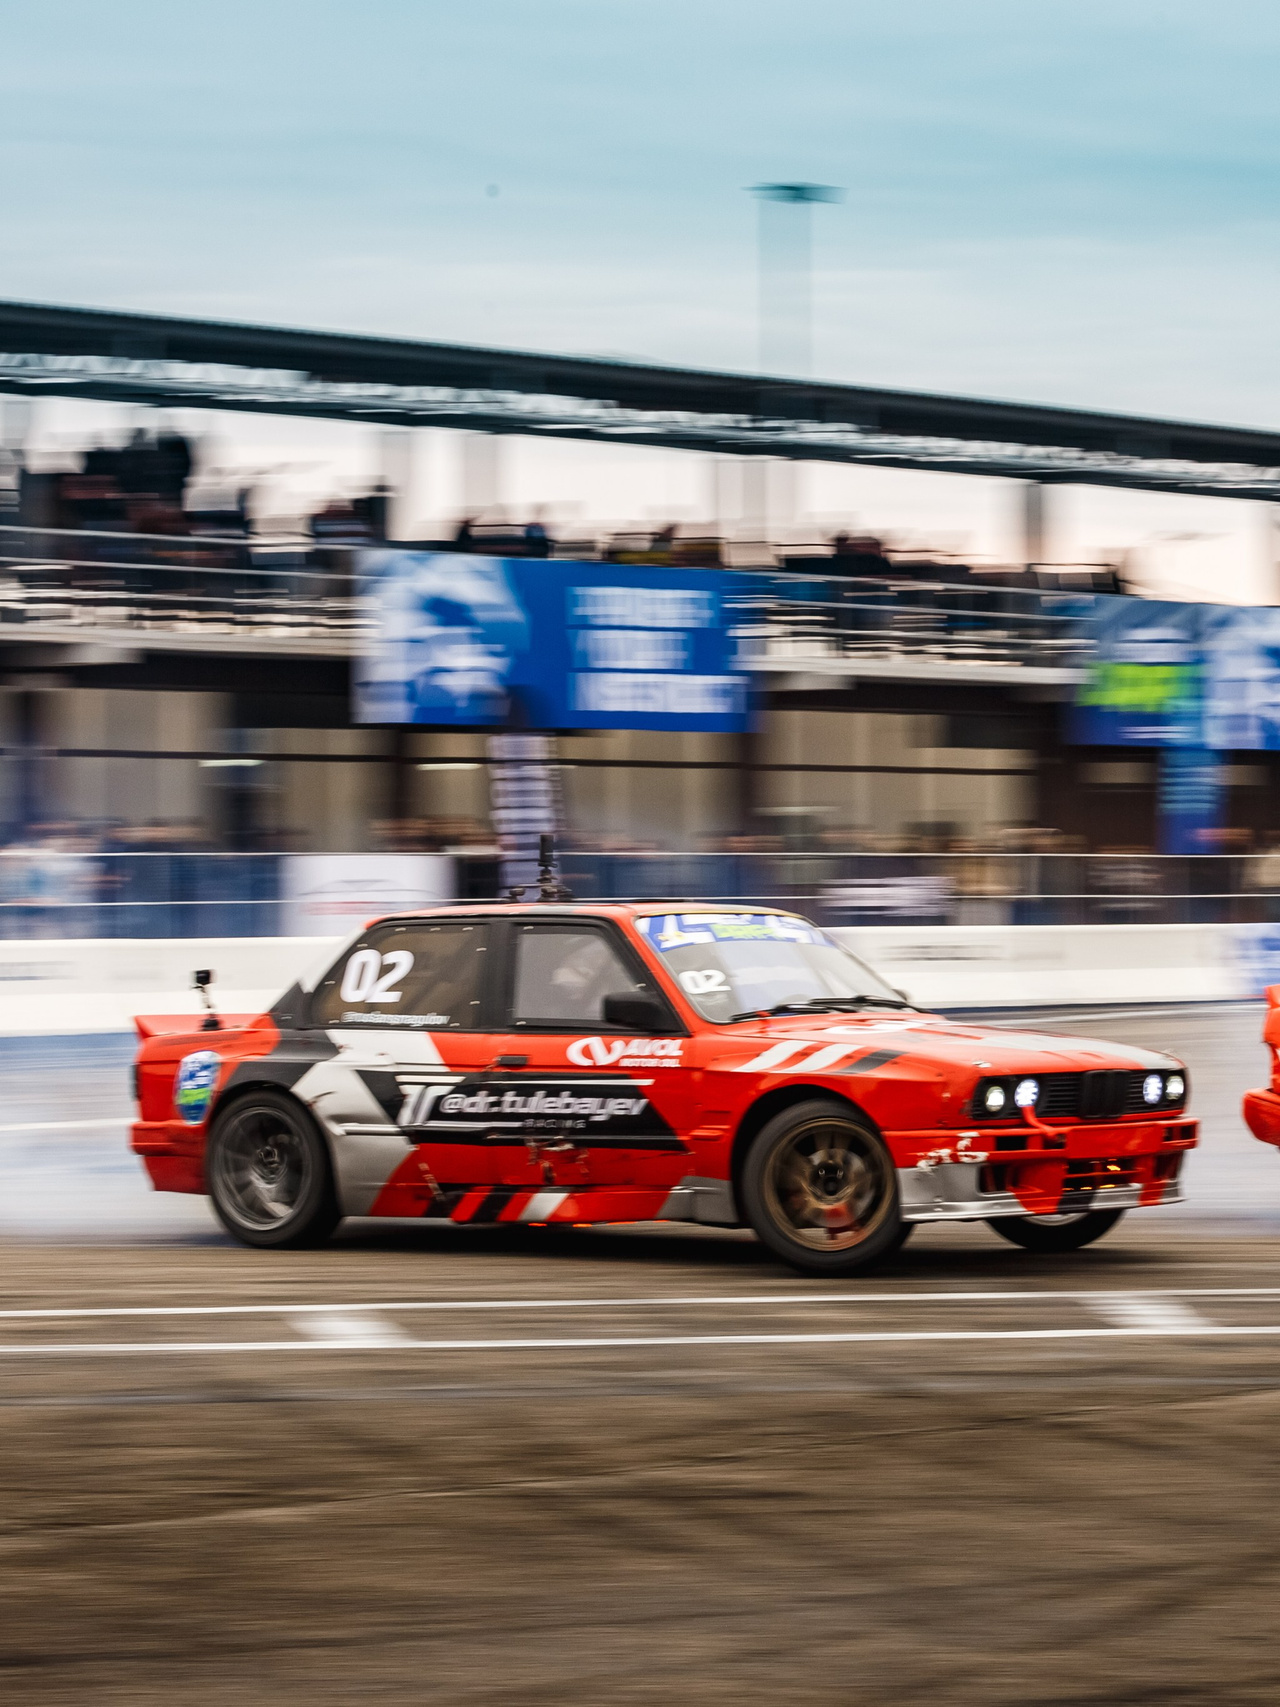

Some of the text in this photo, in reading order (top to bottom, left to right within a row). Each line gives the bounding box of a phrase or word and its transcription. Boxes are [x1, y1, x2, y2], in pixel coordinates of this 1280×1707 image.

[340, 949, 415, 1003] 02
[678, 969, 732, 995] 02
[439, 1091, 649, 1121] @dr.tulebayev
